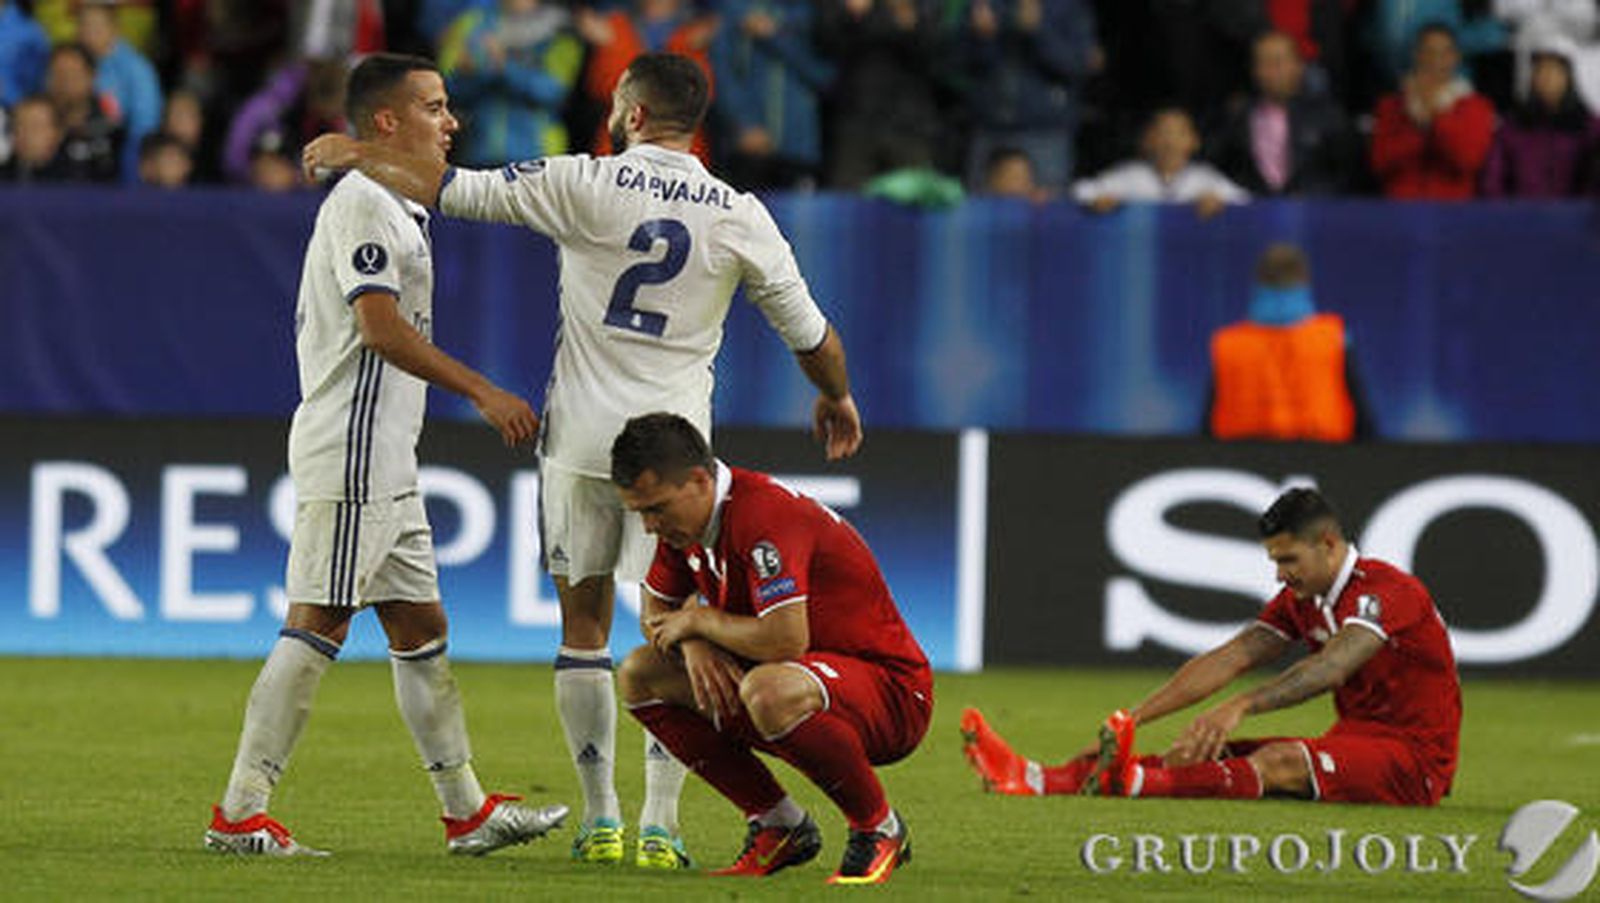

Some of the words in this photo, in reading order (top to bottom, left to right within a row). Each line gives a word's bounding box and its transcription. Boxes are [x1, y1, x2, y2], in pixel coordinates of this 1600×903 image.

[616, 165, 732, 210] CARVAJAL
[603, 218, 692, 337] 2
[30, 461, 860, 622] REPE
